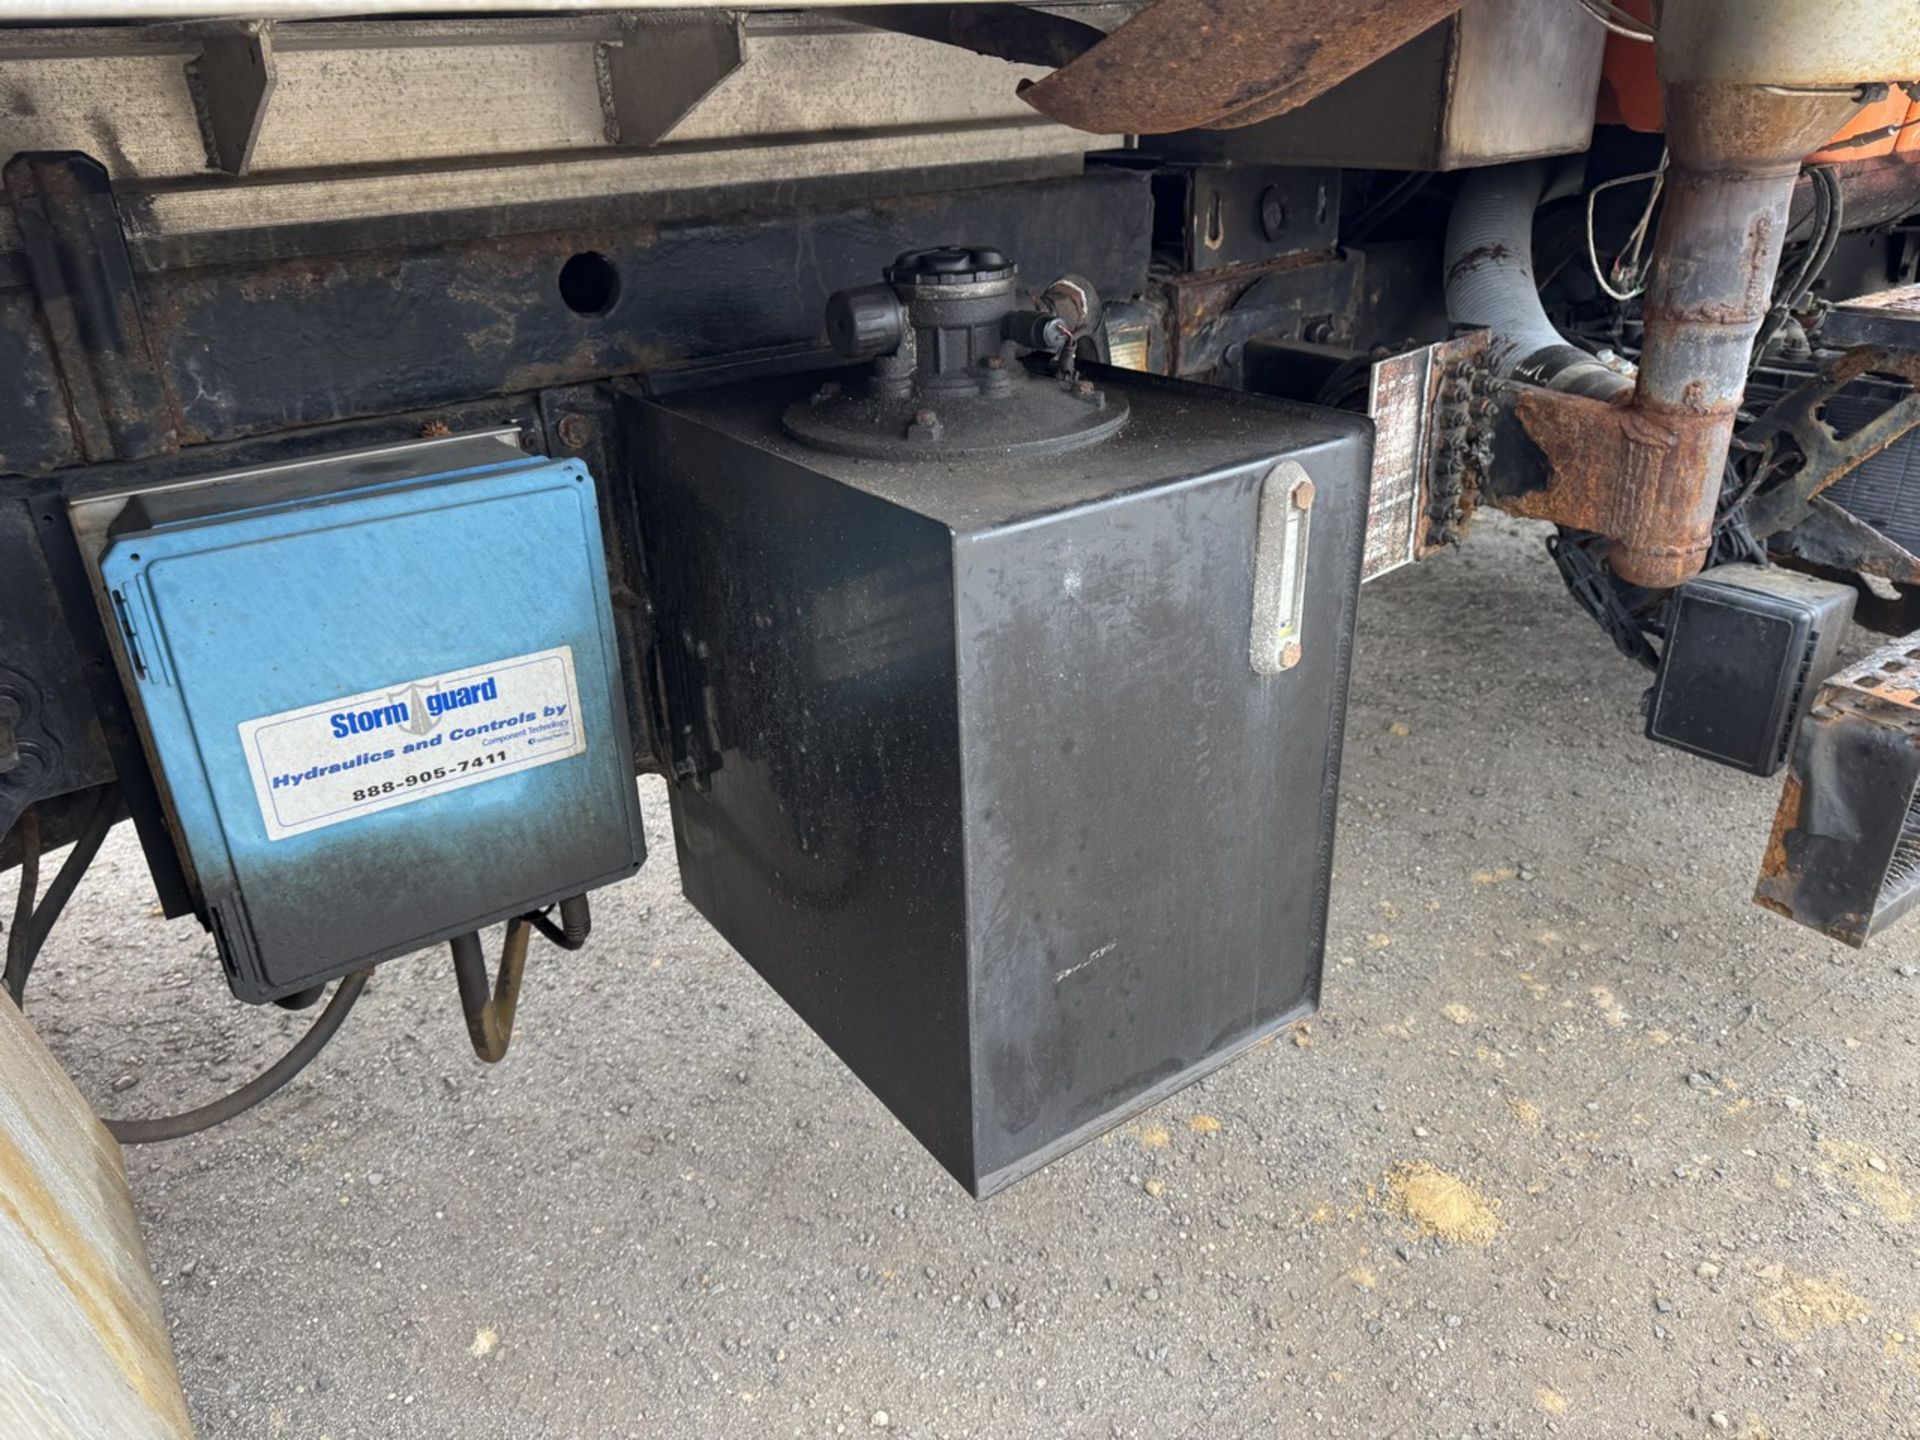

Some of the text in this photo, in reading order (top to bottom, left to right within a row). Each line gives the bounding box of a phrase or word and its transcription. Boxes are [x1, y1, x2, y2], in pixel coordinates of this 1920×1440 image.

[330, 677, 498, 739] Storm guard
[482, 729, 527, 746] Component
[528, 720, 569, 734] Technology
[272, 749, 395, 790] Hydraulics
[402, 734, 443, 754] and
[449, 711, 537, 741] Controls
[543, 704, 567, 717] by
[352, 751, 507, 802] 888-905-7411
